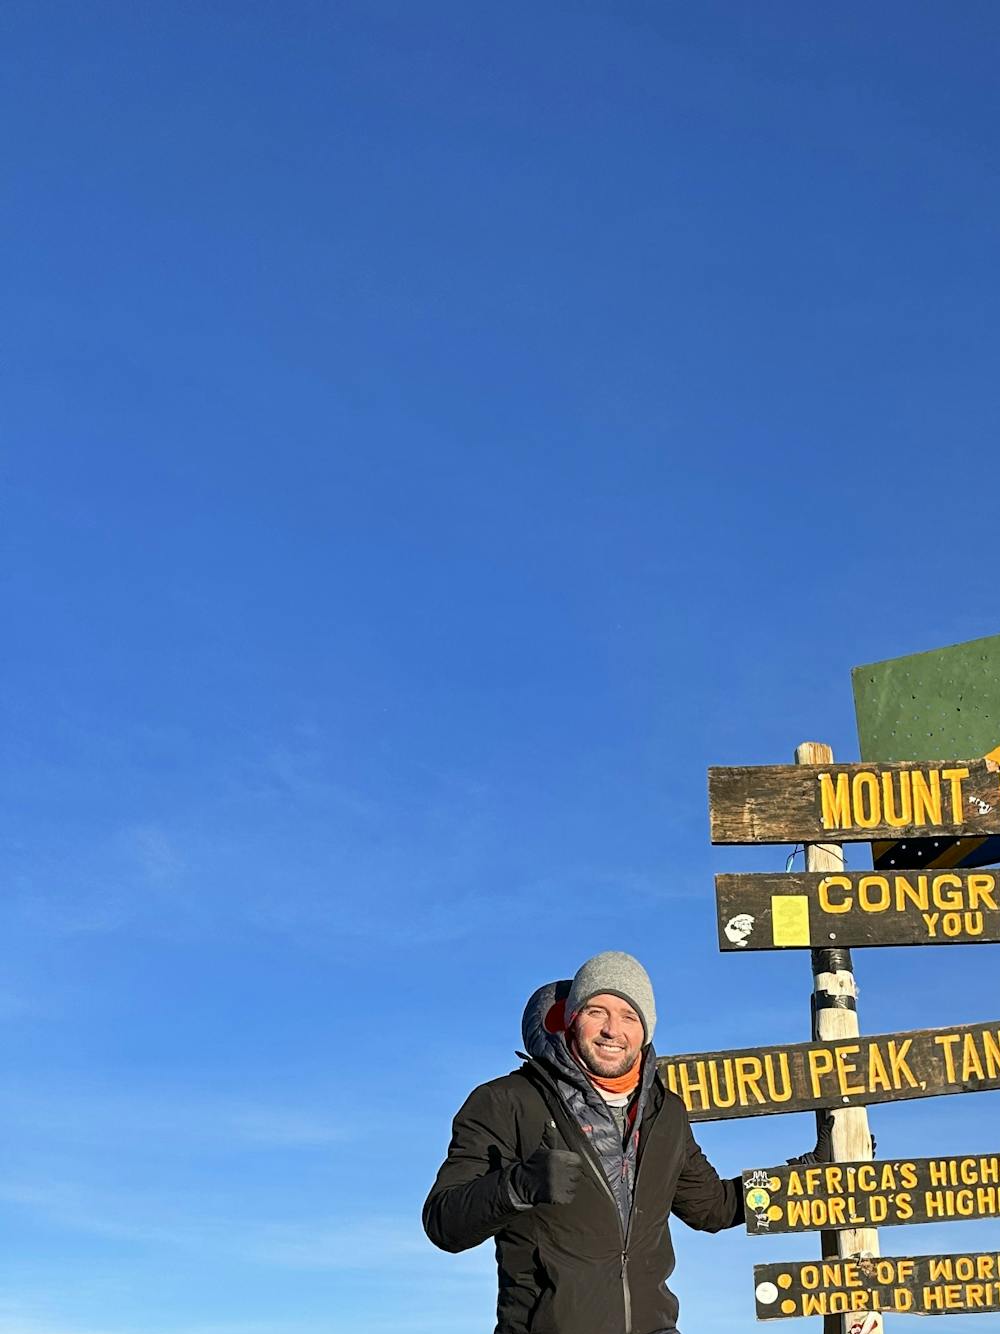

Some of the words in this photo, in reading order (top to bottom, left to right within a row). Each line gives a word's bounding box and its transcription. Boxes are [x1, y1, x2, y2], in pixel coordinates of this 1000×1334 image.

[820, 768, 969, 830] MOUNT
[923, 911, 984, 937] YOU
[808, 1039, 927, 1098] PEAK,
[788, 1162, 918, 1196] AFRICA'S
[787, 1192, 914, 1227] WORLD'S
[800, 1262, 861, 1290] ONE
[874, 1260, 913, 1285] OF
[801, 1287, 913, 1316] WORLD
